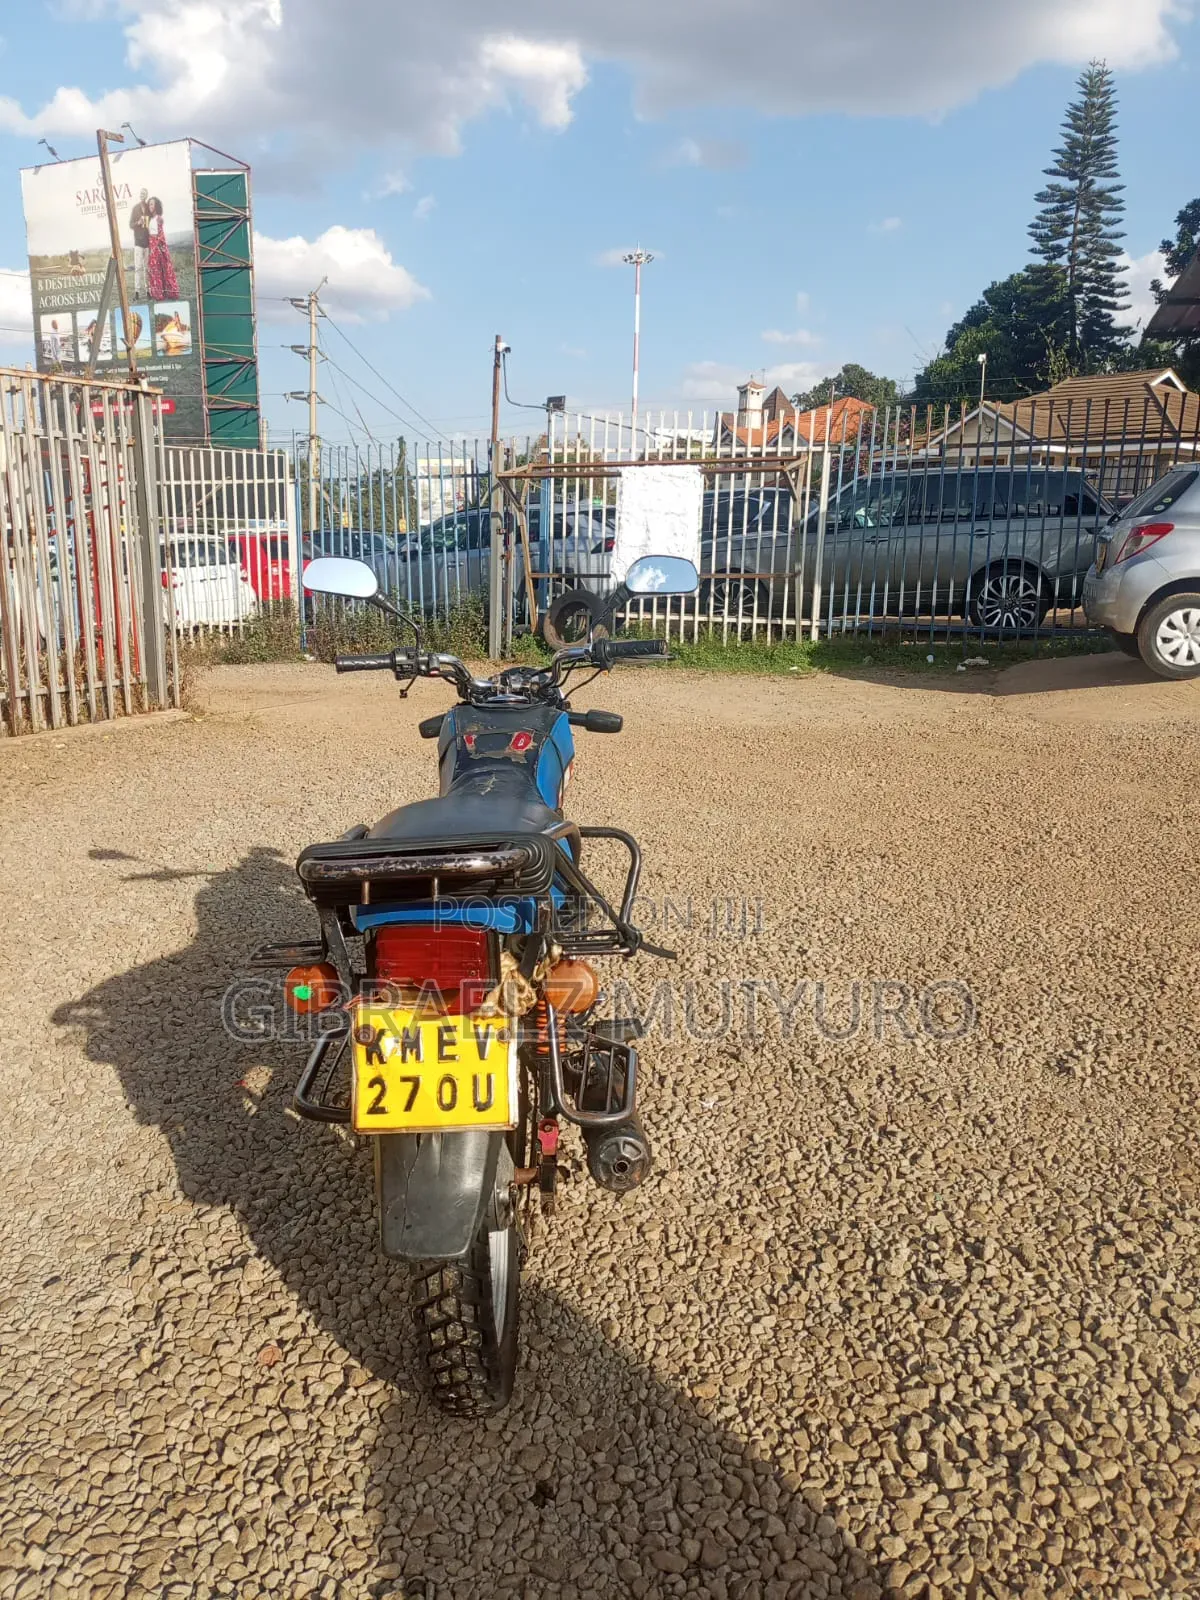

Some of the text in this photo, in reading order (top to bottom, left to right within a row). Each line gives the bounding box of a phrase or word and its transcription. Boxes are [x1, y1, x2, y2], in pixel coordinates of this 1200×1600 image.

[45, 271, 106, 290] DESTINATION
[39, 289, 102, 308] ACROSS KENY
[365, 1024, 494, 1065] KMEV
[366, 1073, 495, 1115] 270U
